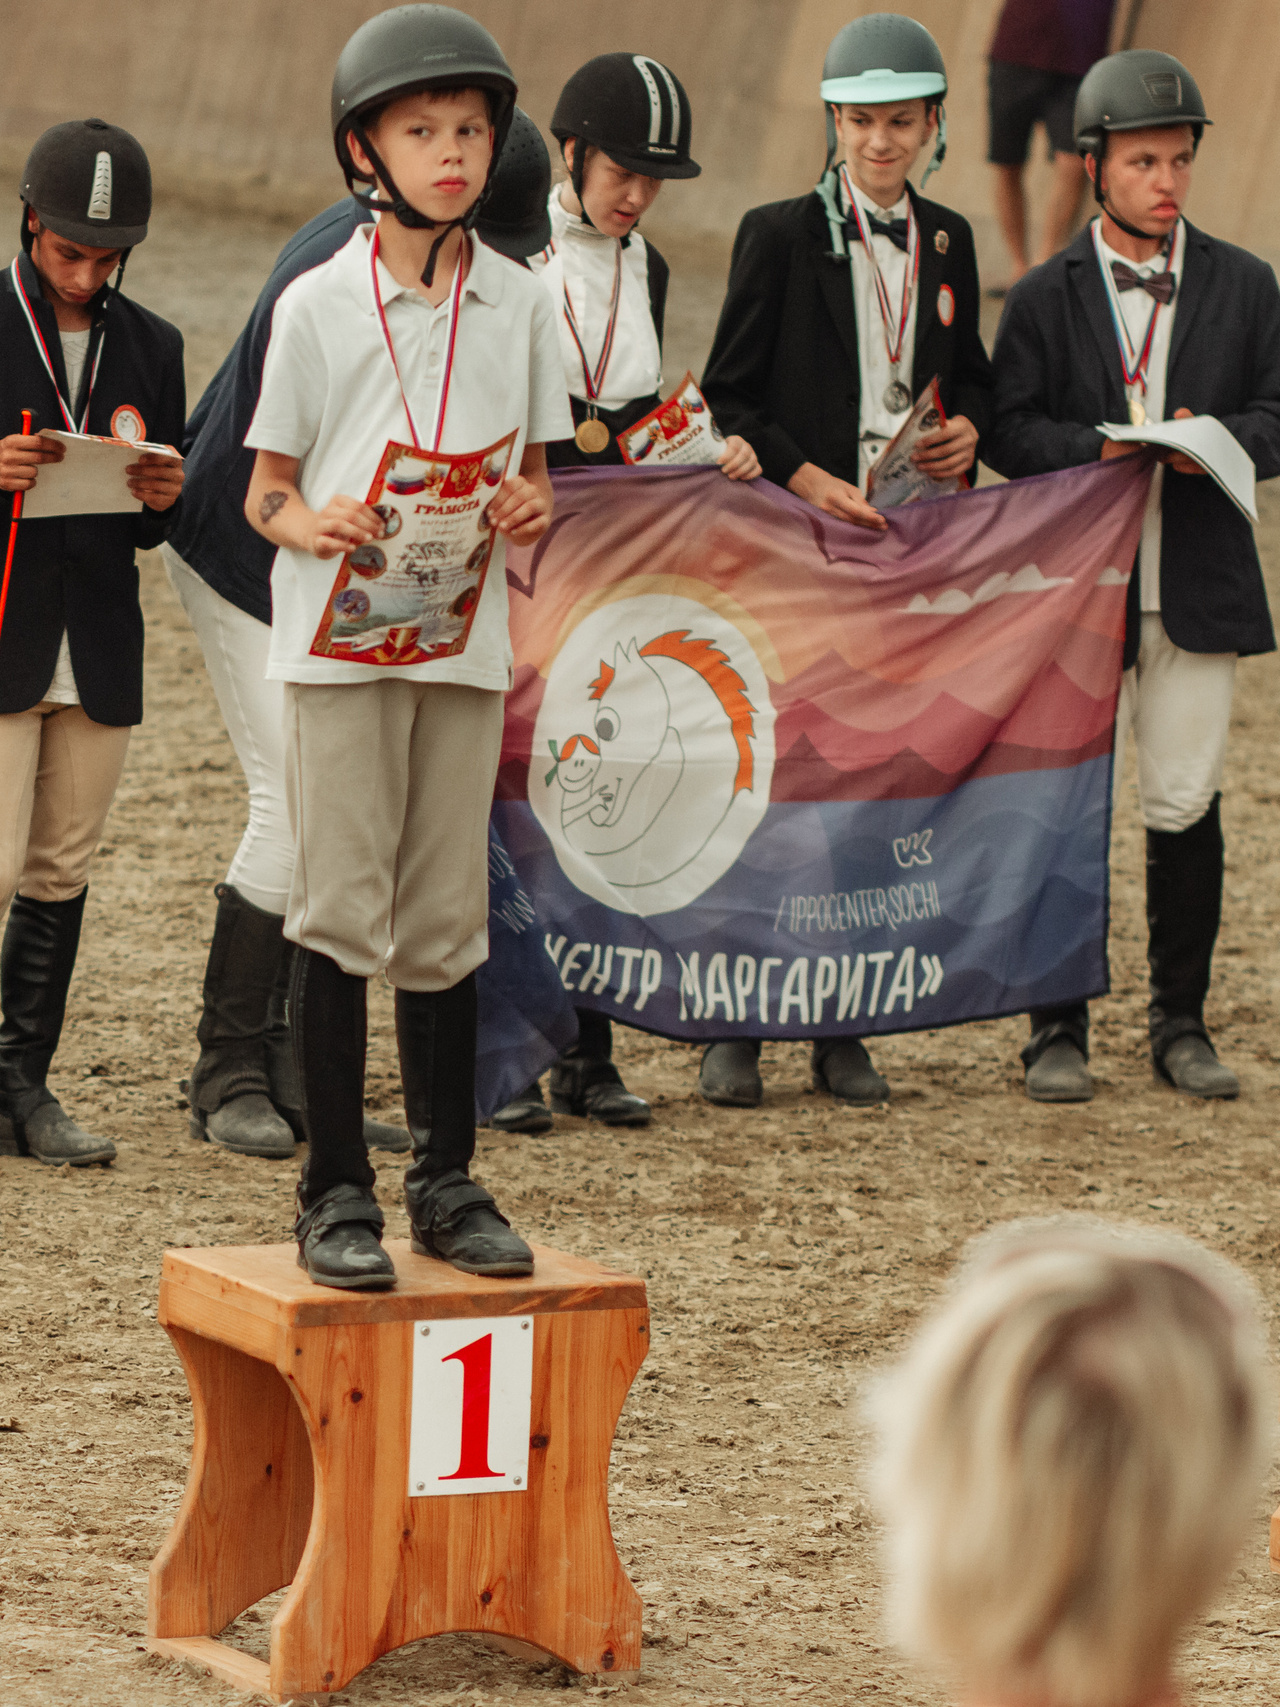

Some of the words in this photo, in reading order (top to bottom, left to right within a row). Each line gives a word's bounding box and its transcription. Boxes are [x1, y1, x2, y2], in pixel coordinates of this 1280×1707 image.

[656, 424, 704, 460] ГРАМОТА
[414, 498, 480, 515] ГРАМОТА
[676, 945, 945, 1025] МАРГАРИТА»
[438, 1333, 506, 1481] 1
